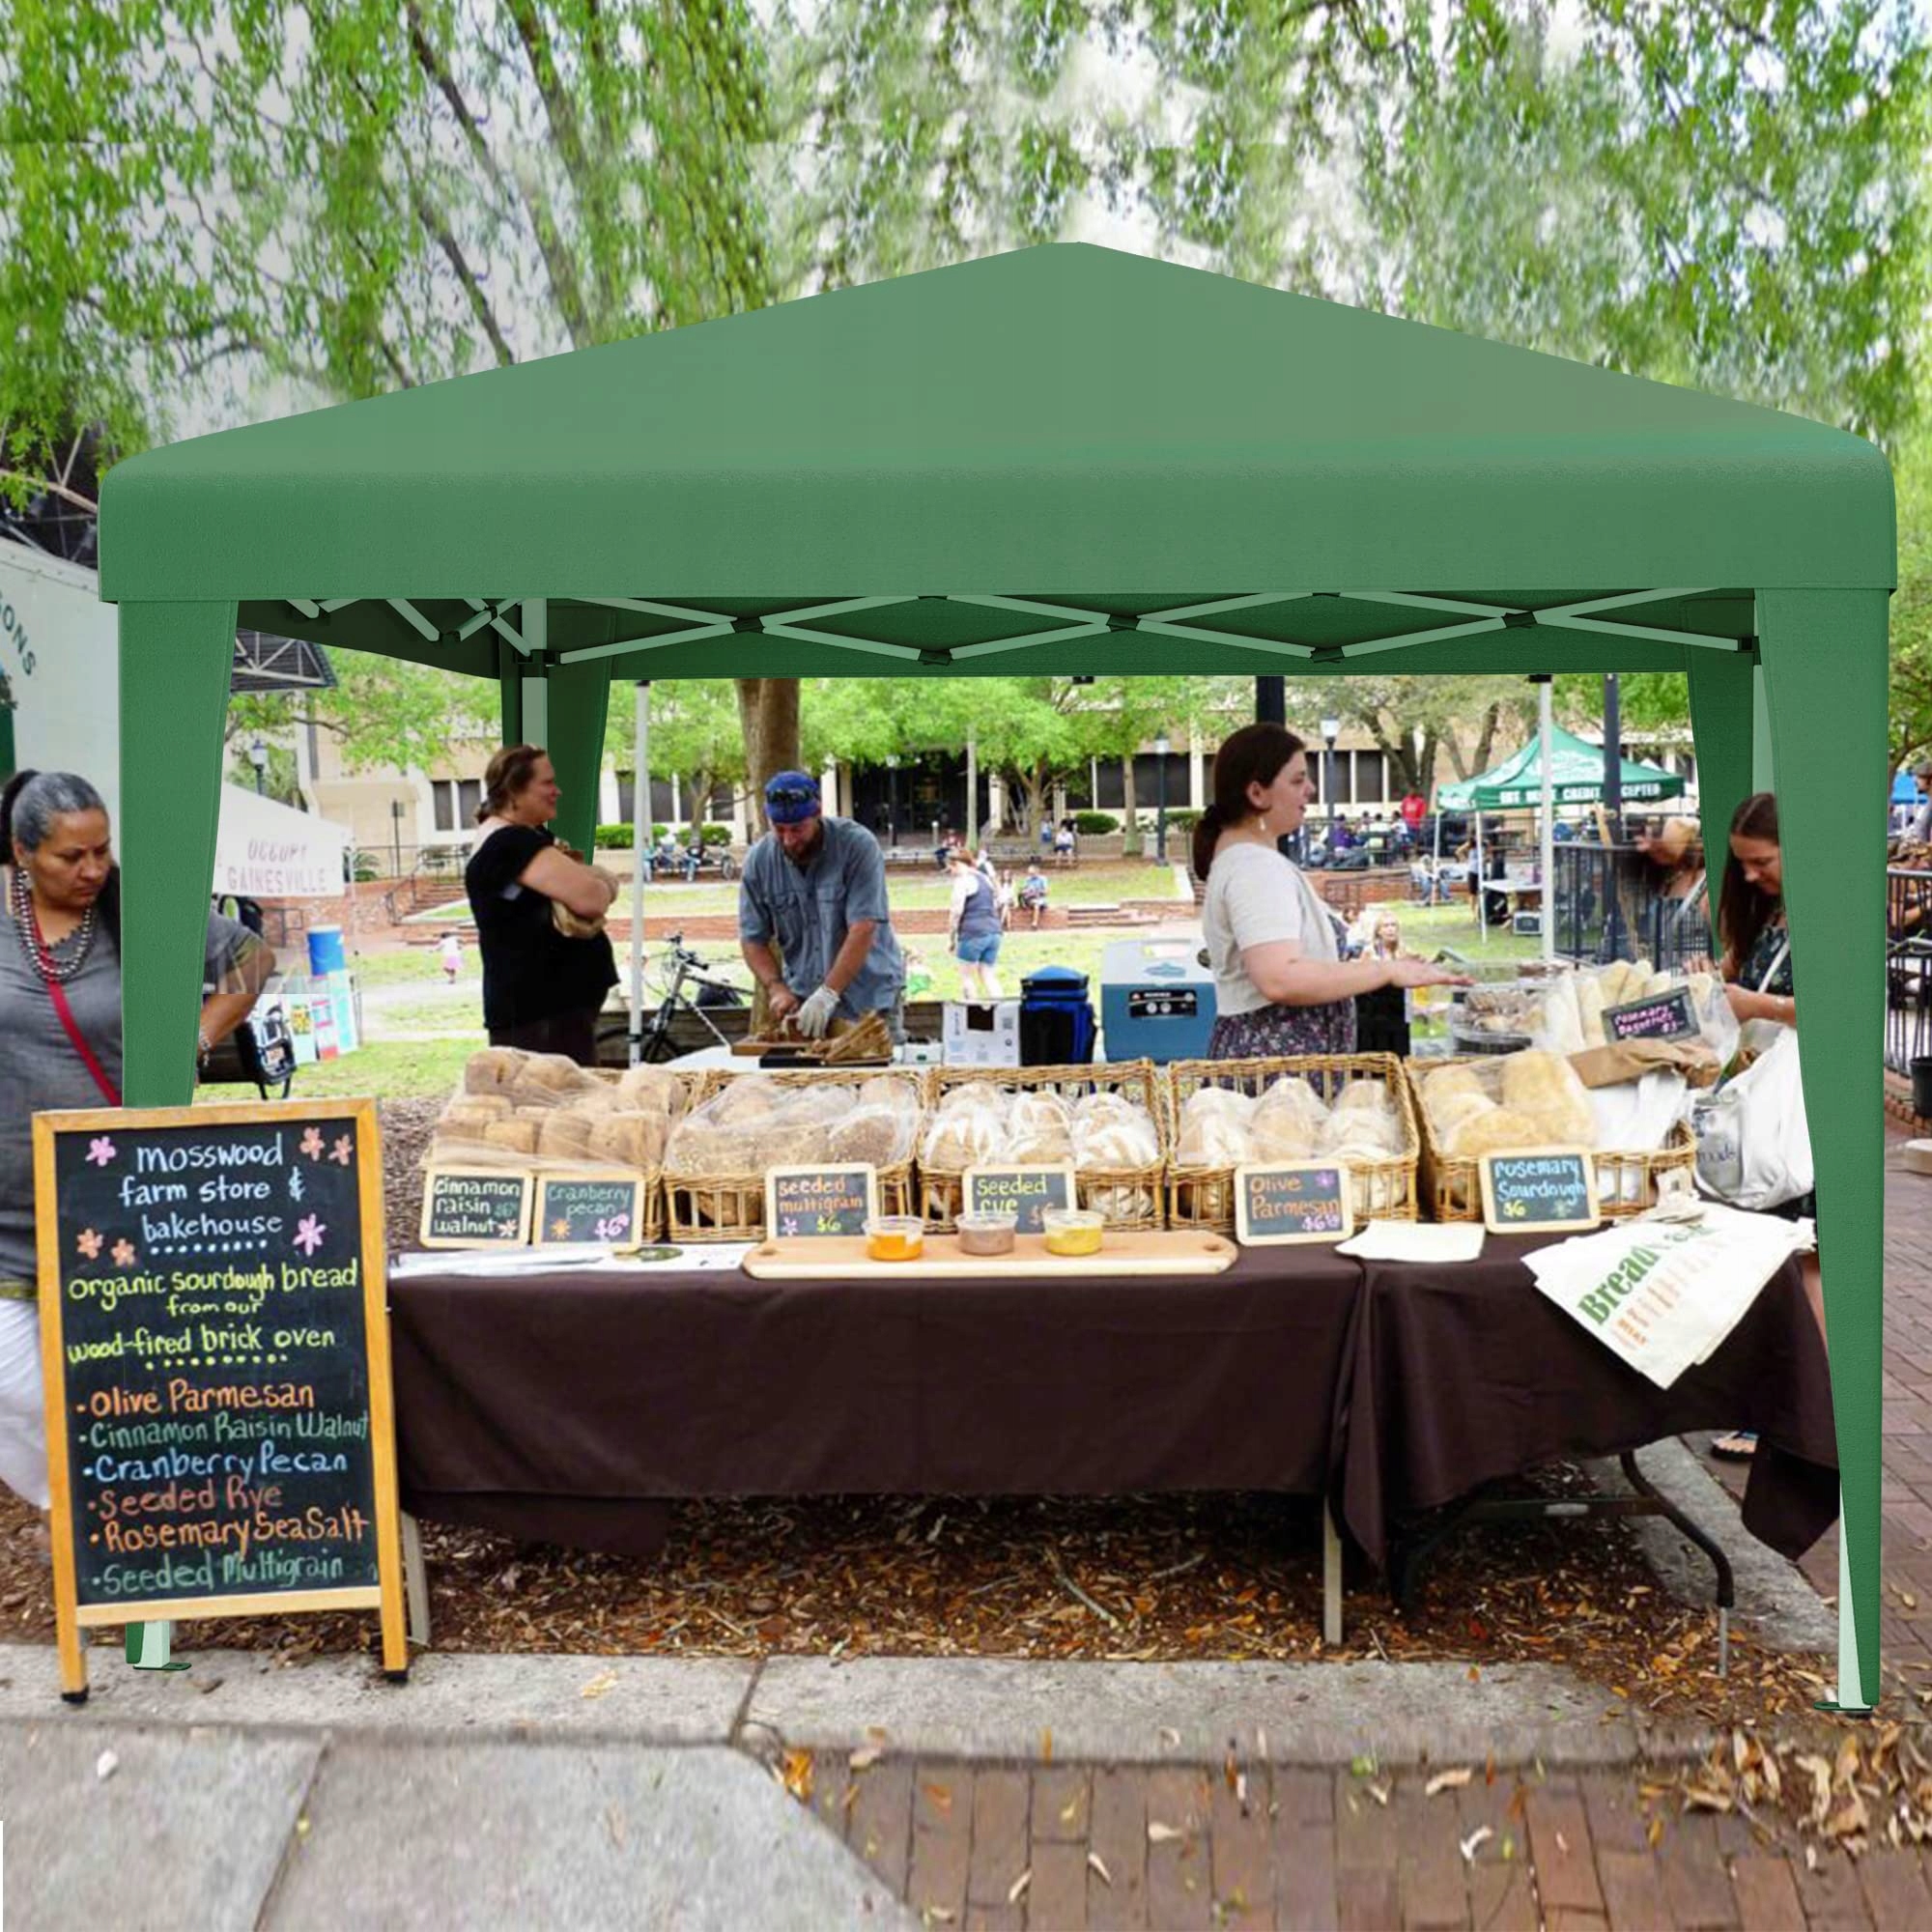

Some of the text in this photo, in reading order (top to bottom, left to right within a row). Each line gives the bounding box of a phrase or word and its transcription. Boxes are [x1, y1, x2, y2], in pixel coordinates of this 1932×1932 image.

[0, 590, 37, 675] ONS
[1562, 785, 1602, 802] CREDIT
[1620, 781, 1661, 799] CEPTED
[226, 866, 327, 894] GAINESVILLE
[136, 1131, 284, 1174] mosswood
[118, 1166, 307, 1208] farm store &
[436, 1196, 491, 1214] raisin
[1250, 1176, 1303, 1194] Olive
[141, 1211, 284, 1243] bakehouse
[433, 1214, 497, 1234] walnut
[565, 1203, 617, 1220] pecan
[816, 1214, 841, 1233] $6
[1251, 1195, 1340, 1220] Parmesan
[1502, 1199, 1526, 1217] $6
[69, 1257, 358, 1312] organic sourdough bread
[1577, 1245, 1660, 1325] Bread
[166, 1293, 265, 1318] from our
[67, 1322, 336, 1364] wood-fired brick oven
[90, 1378, 315, 1418] Olive Parmesan
[89, 1410, 371, 1450] Cinnamon Raisin Walnut
[95, 1439, 349, 1484] Cranberry Pecan
[97, 1474, 284, 1521] Seeded Rye
[104, 1499, 371, 1560] Rosemary Sea Salt
[101, 1548, 344, 1595] Seeded Multigrain
